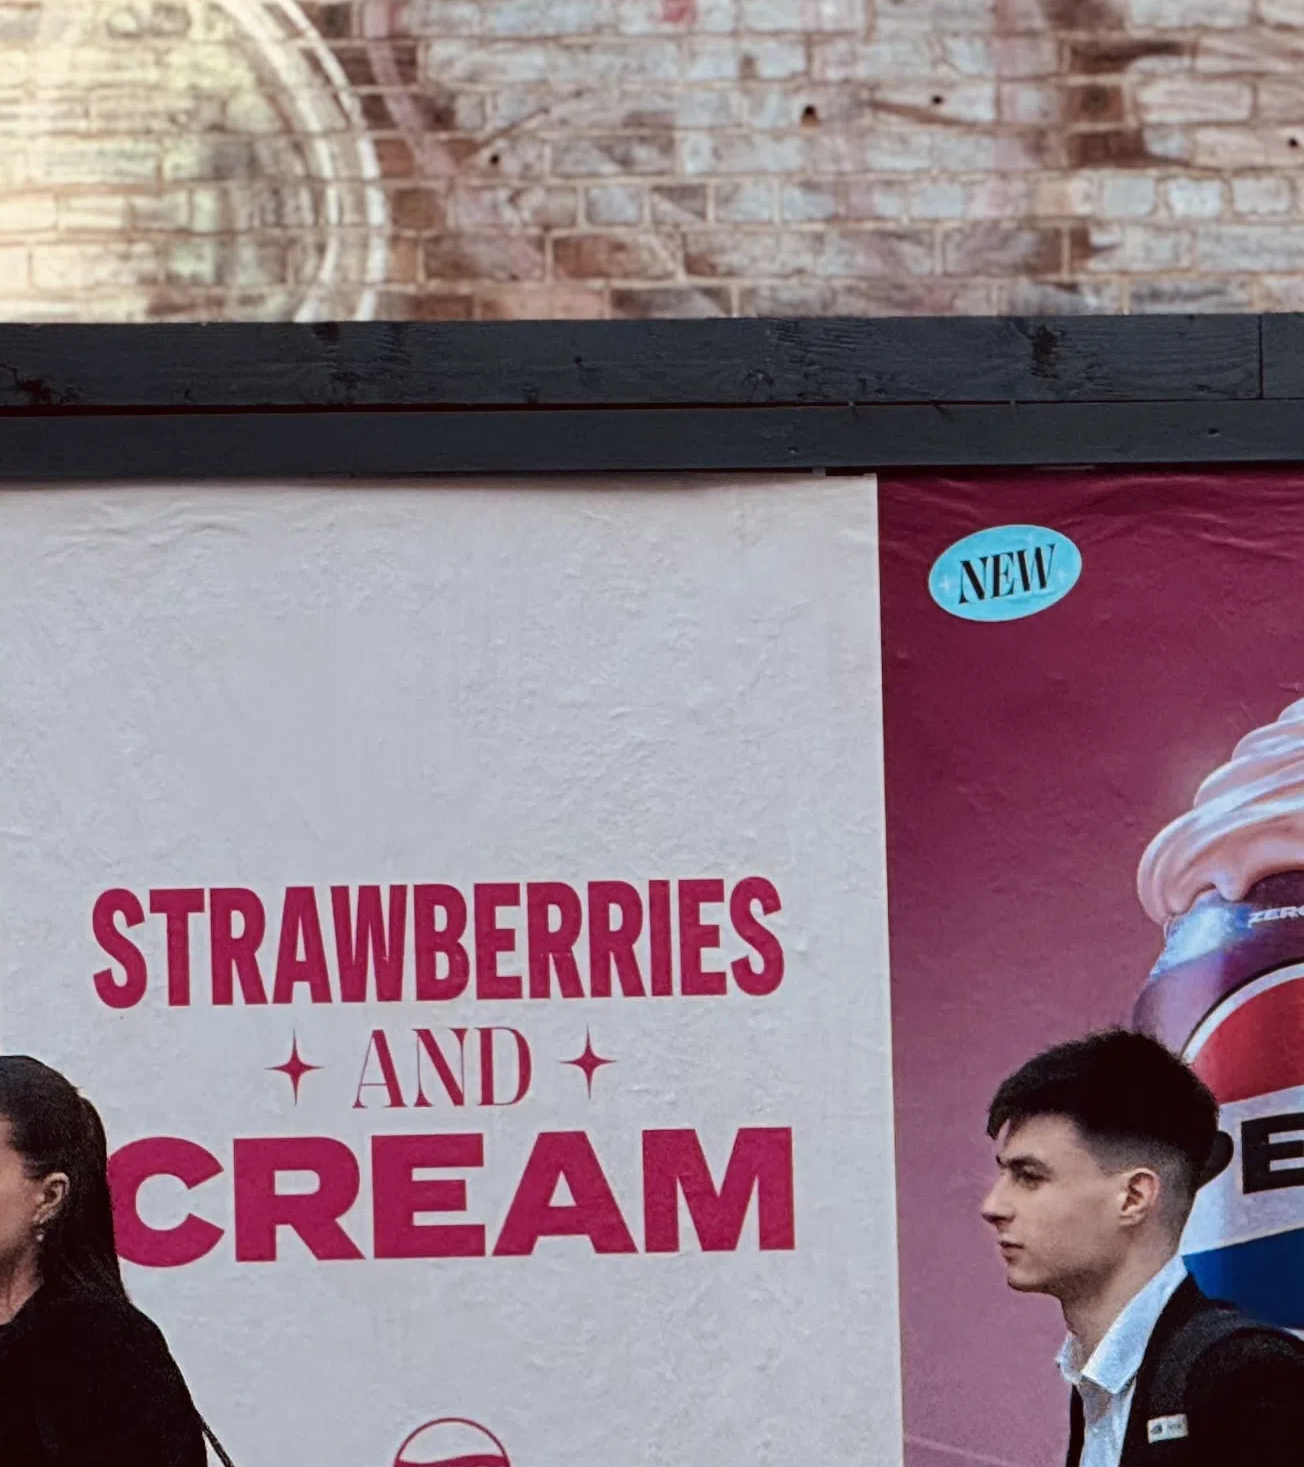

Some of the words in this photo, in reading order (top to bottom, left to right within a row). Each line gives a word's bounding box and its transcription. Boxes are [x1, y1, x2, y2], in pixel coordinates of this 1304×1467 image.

[957, 543, 1057, 605] NEW
[92, 876, 784, 1009] STRAWBERRIES
[353, 1026, 532, 1109] AND
[108, 1127, 795, 1268] CREAM
